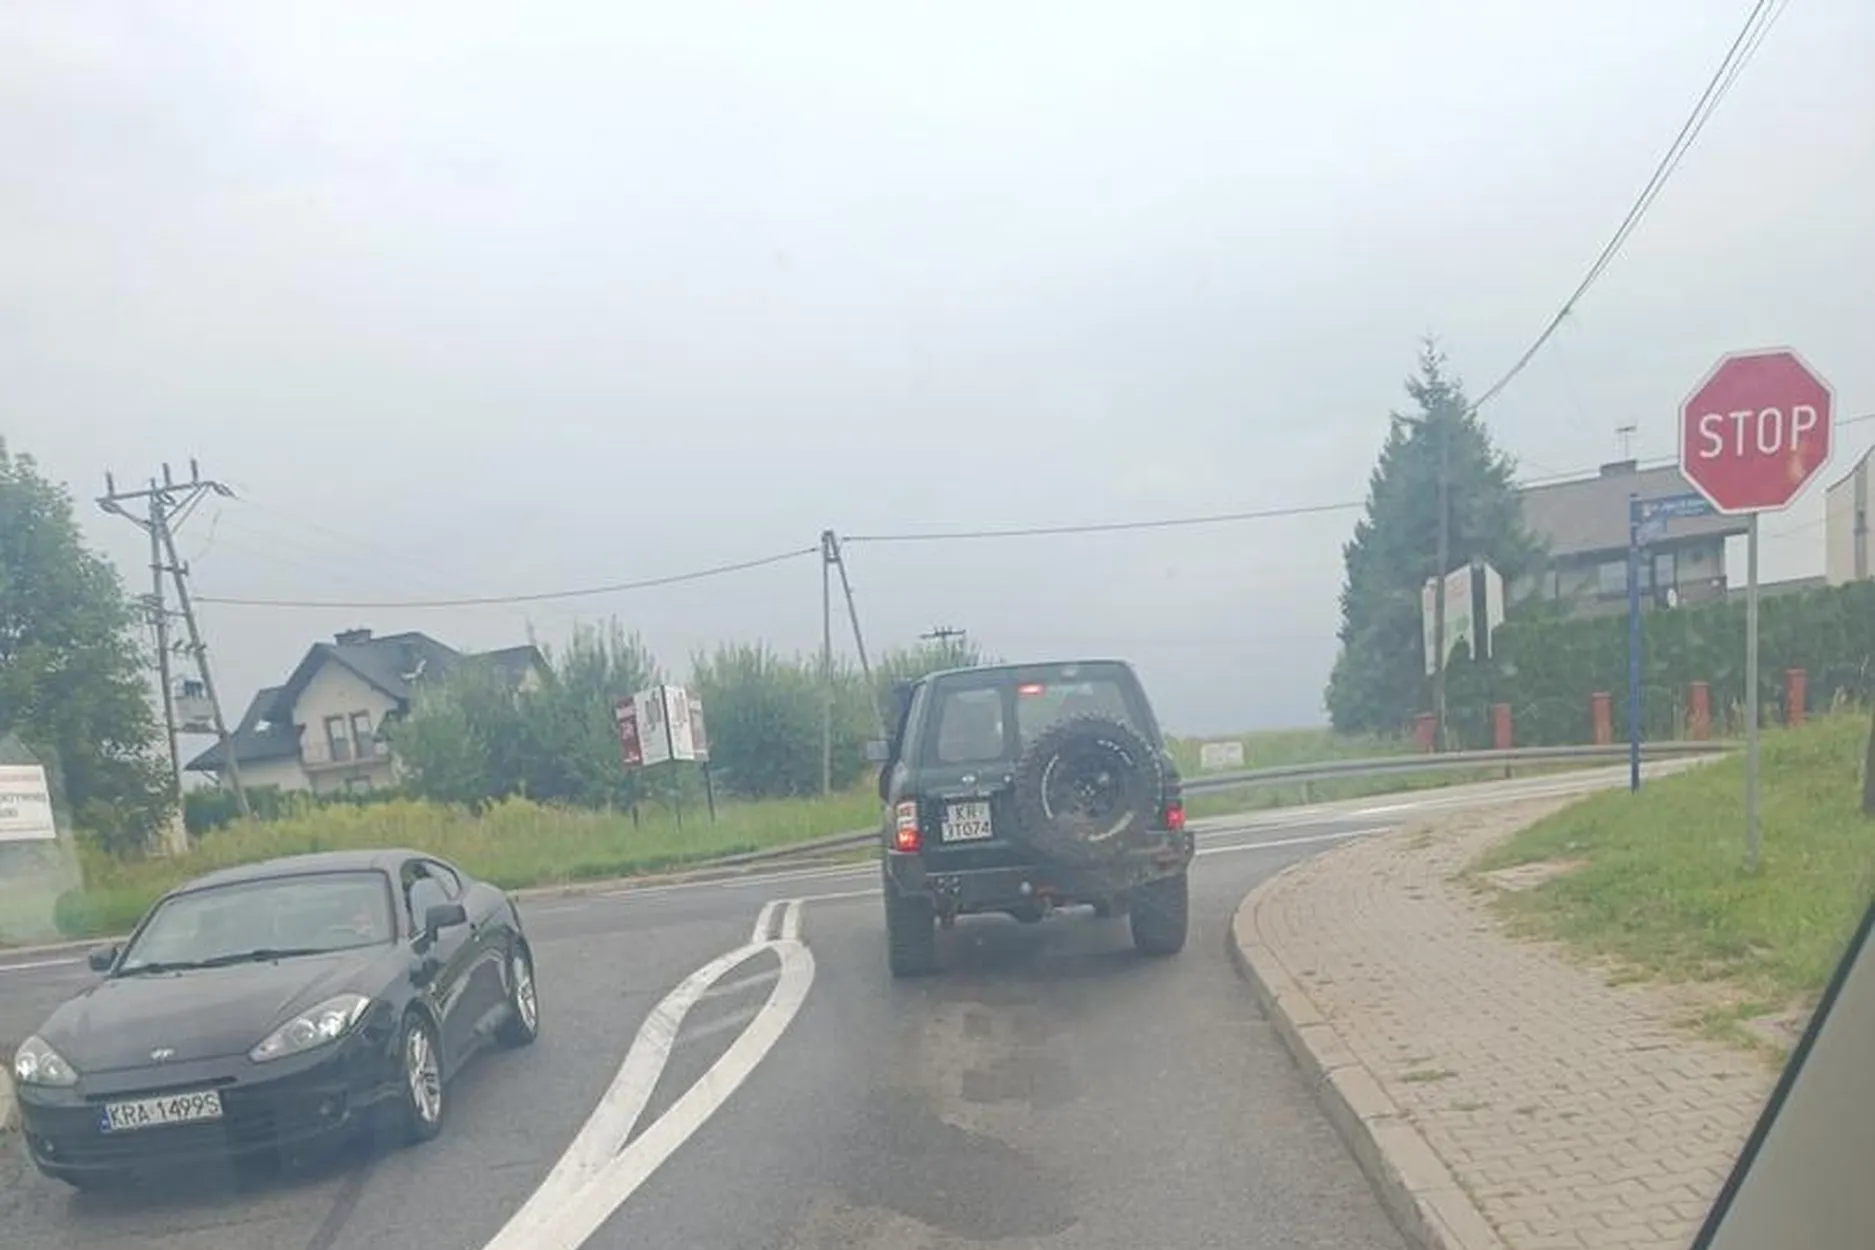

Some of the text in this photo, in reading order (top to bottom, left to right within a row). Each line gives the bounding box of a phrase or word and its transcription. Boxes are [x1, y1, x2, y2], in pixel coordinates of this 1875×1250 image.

[1699, 404, 1817, 458] STOP
[108, 1093, 219, 1127] KRA 1499S
